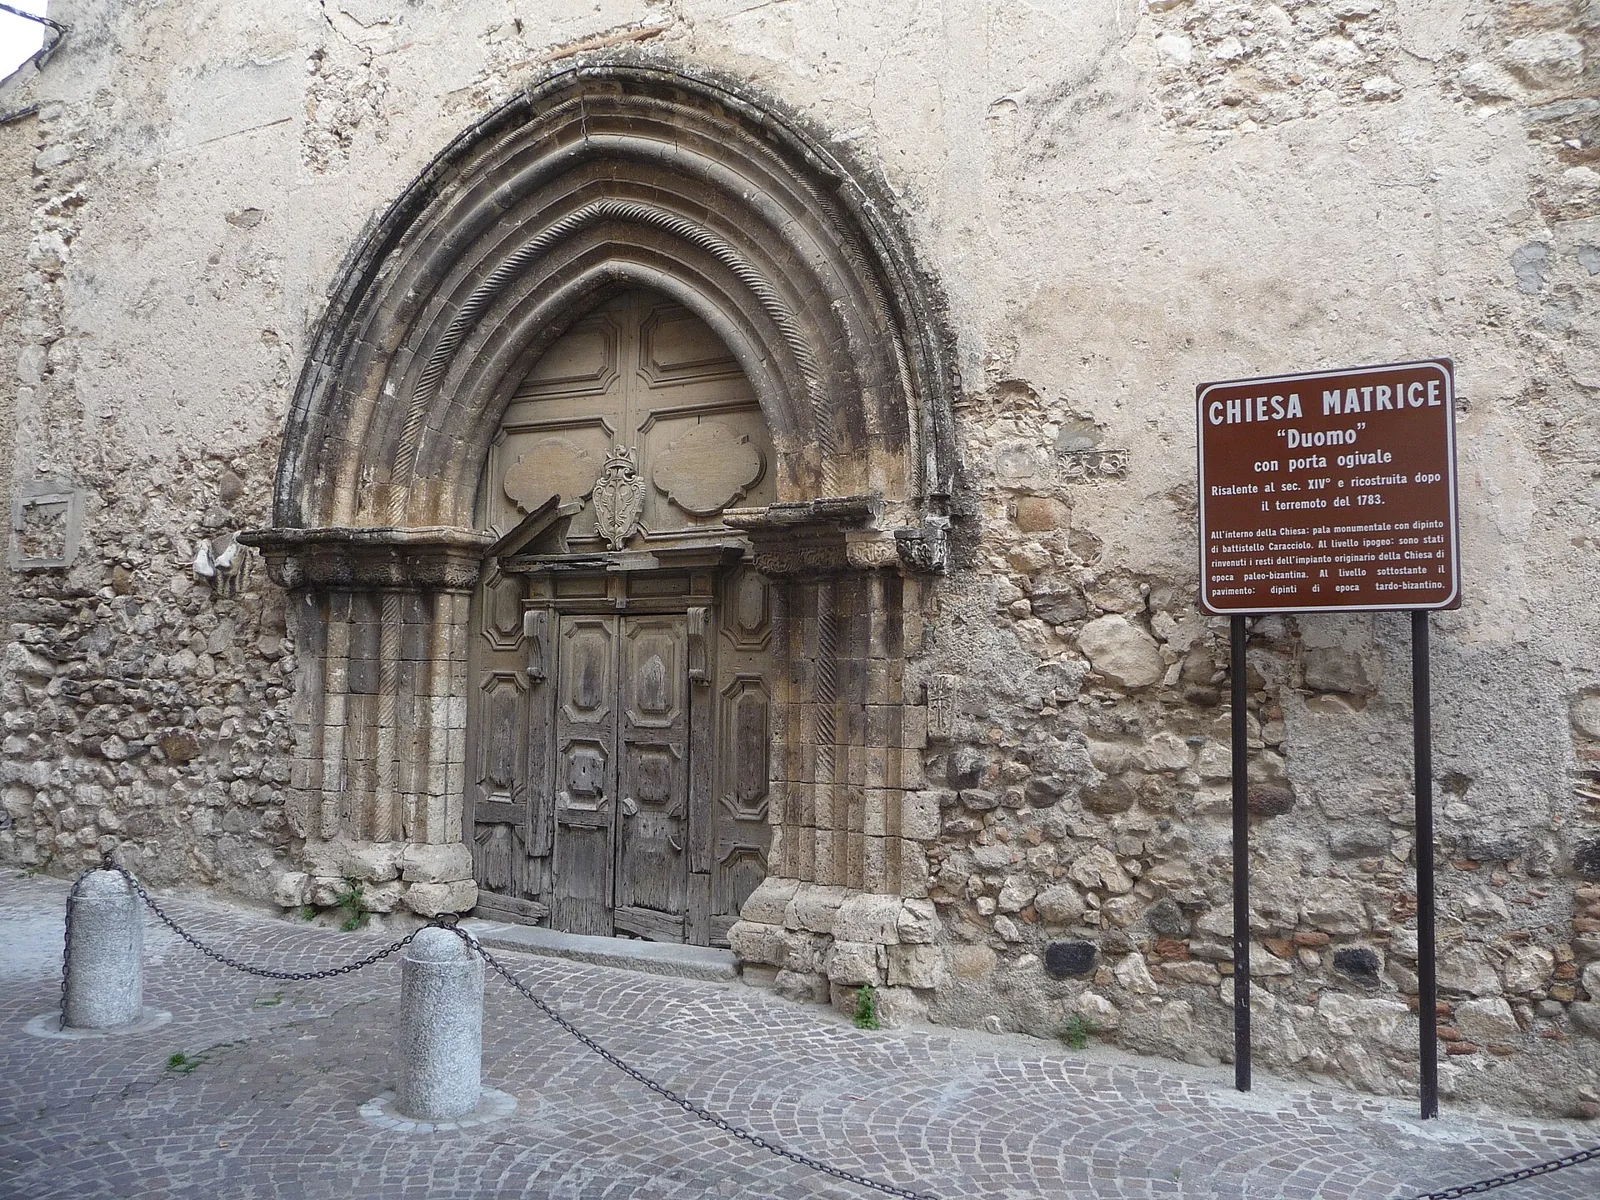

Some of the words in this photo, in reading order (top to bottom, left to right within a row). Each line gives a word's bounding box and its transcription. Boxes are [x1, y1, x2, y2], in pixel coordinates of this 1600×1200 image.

[1209, 394, 1303, 426] CHIESA
[1322, 379, 1441, 416] MATRICE
[1254, 458, 1279, 472] con
[1289, 455, 1327, 472] porta
[1337, 449, 1392, 468] ogivale
[1211, 484, 1258, 496] Risalente
[1264, 482, 1275, 492] al
[1281, 482, 1301, 491] sec.
[1351, 474, 1407, 487] ricostruita
[1415, 472, 1441, 484] dopo
[1261, 501, 1269, 511] il
[1275, 498, 1327, 511] terremoto
[1333, 496, 1351, 507] del
[1357, 494, 1385, 506] 1783.
[1256, 528, 1277, 537] della
[1280, 527, 1309, 536] Chiesa:
[1313, 525, 1331, 536] pala
[1334, 522, 1391, 533] monumentale
[1412, 520, 1444, 530] dipinto
[1211, 545, 1219, 553] di
[1222, 543, 1265, 553] battistello
[1268, 540, 1314, 551] Caracciolo.
[1318, 540, 1327, 549] Al
[1331, 538, 1359, 548] livello
[1363, 537, 1394, 548] ipogeo:
[1399, 537, 1419, 545] sono
[1423, 535, 1444, 544] stati
[1211, 558, 1247, 568] rinvenuti
[1255, 556, 1274, 566] resti
[1335, 553, 1376, 564] originario
[1378, 551, 1401, 560] della
[1404, 550, 1433, 559] Chiesa
[1436, 549, 1445, 559] di
[1211, 573, 1234, 583] epoca
[1244, 570, 1309, 582] paleo-bizantina.
[1319, 569, 1329, 578] Al
[1338, 568, 1367, 577] livello
[1377, 565, 1427, 576] sottostante
[1438, 565, 1446, 574] il
[1212, 585, 1256, 597] pavimento:
[1270, 584, 1297, 594] dipinti
[1312, 583, 1320, 593] di
[1335, 585, 1360, 593] epoca
[1375, 580, 1446, 591] tardo-bizantino.
